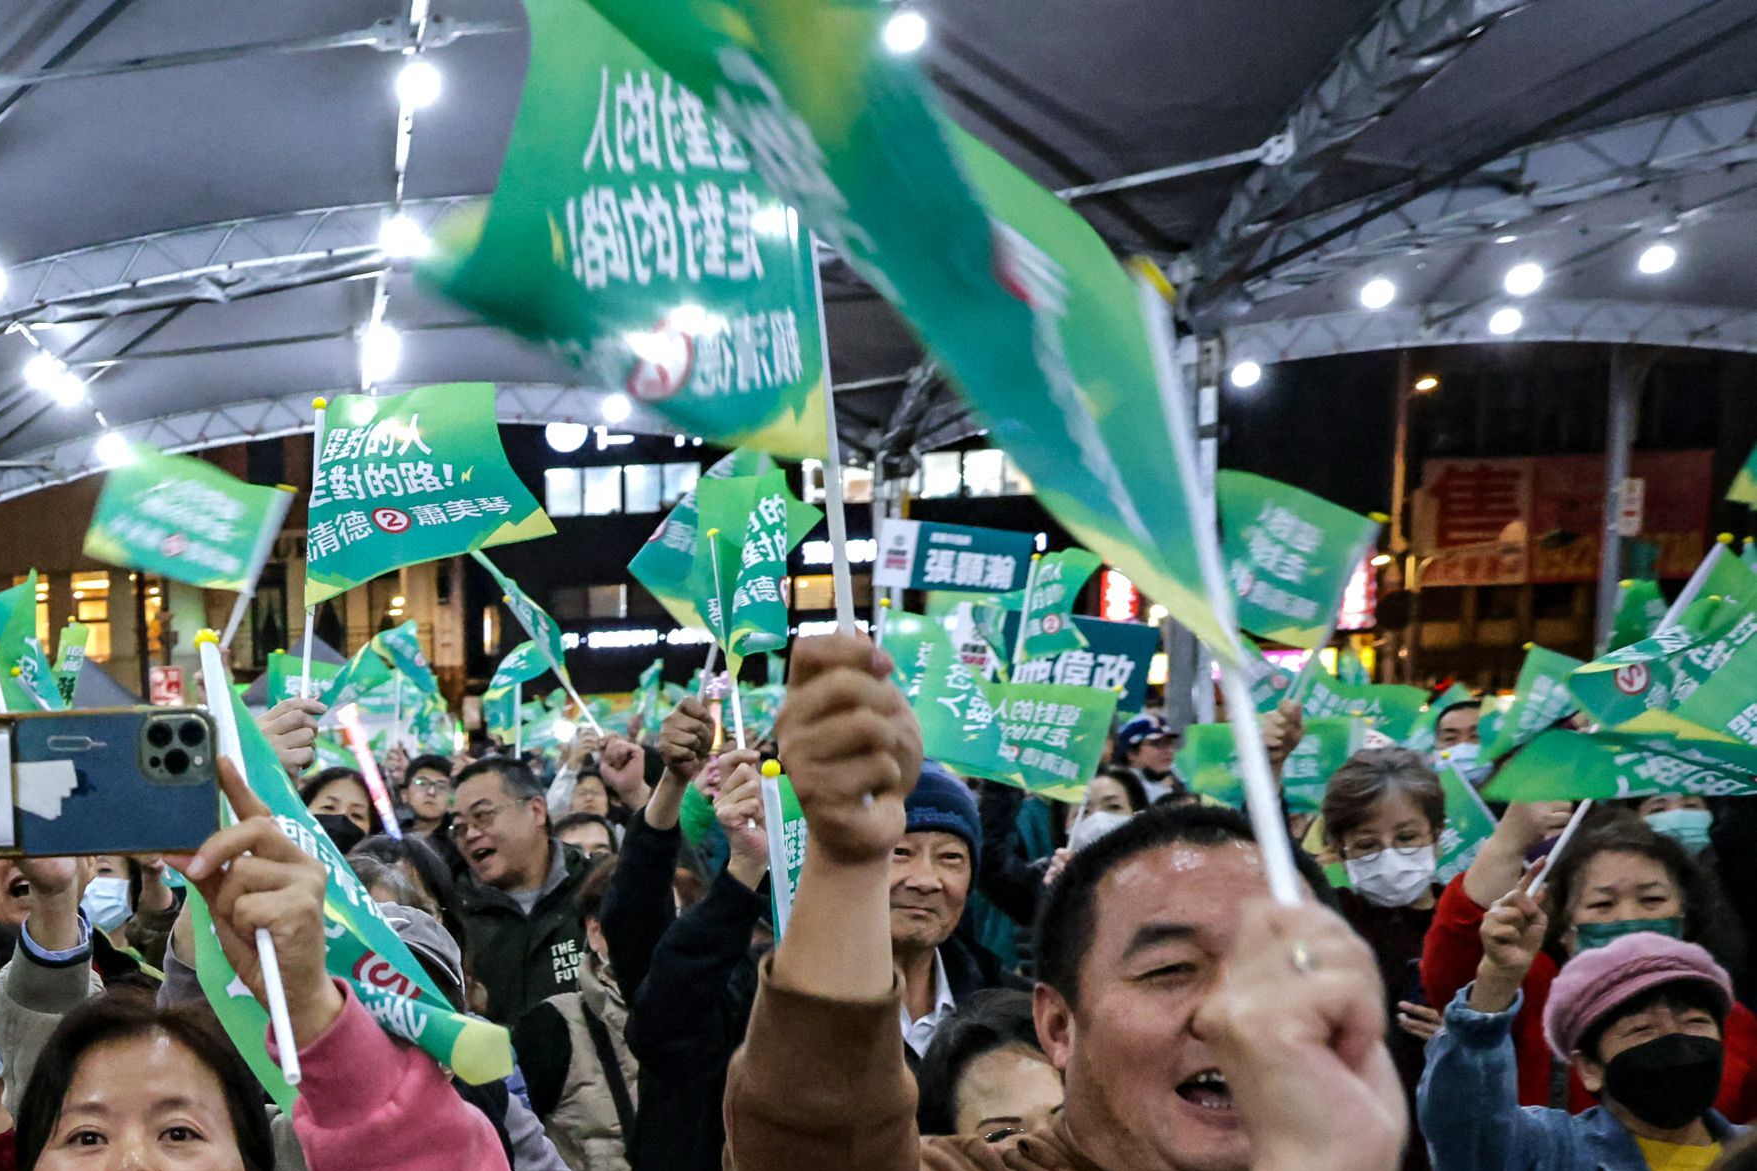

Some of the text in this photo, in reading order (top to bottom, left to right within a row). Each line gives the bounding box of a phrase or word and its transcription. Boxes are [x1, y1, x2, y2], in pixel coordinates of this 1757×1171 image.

[306, 510, 373, 563] 清德
[409, 496, 512, 527] 蕭美琴
[551, 939, 576, 957] THE
